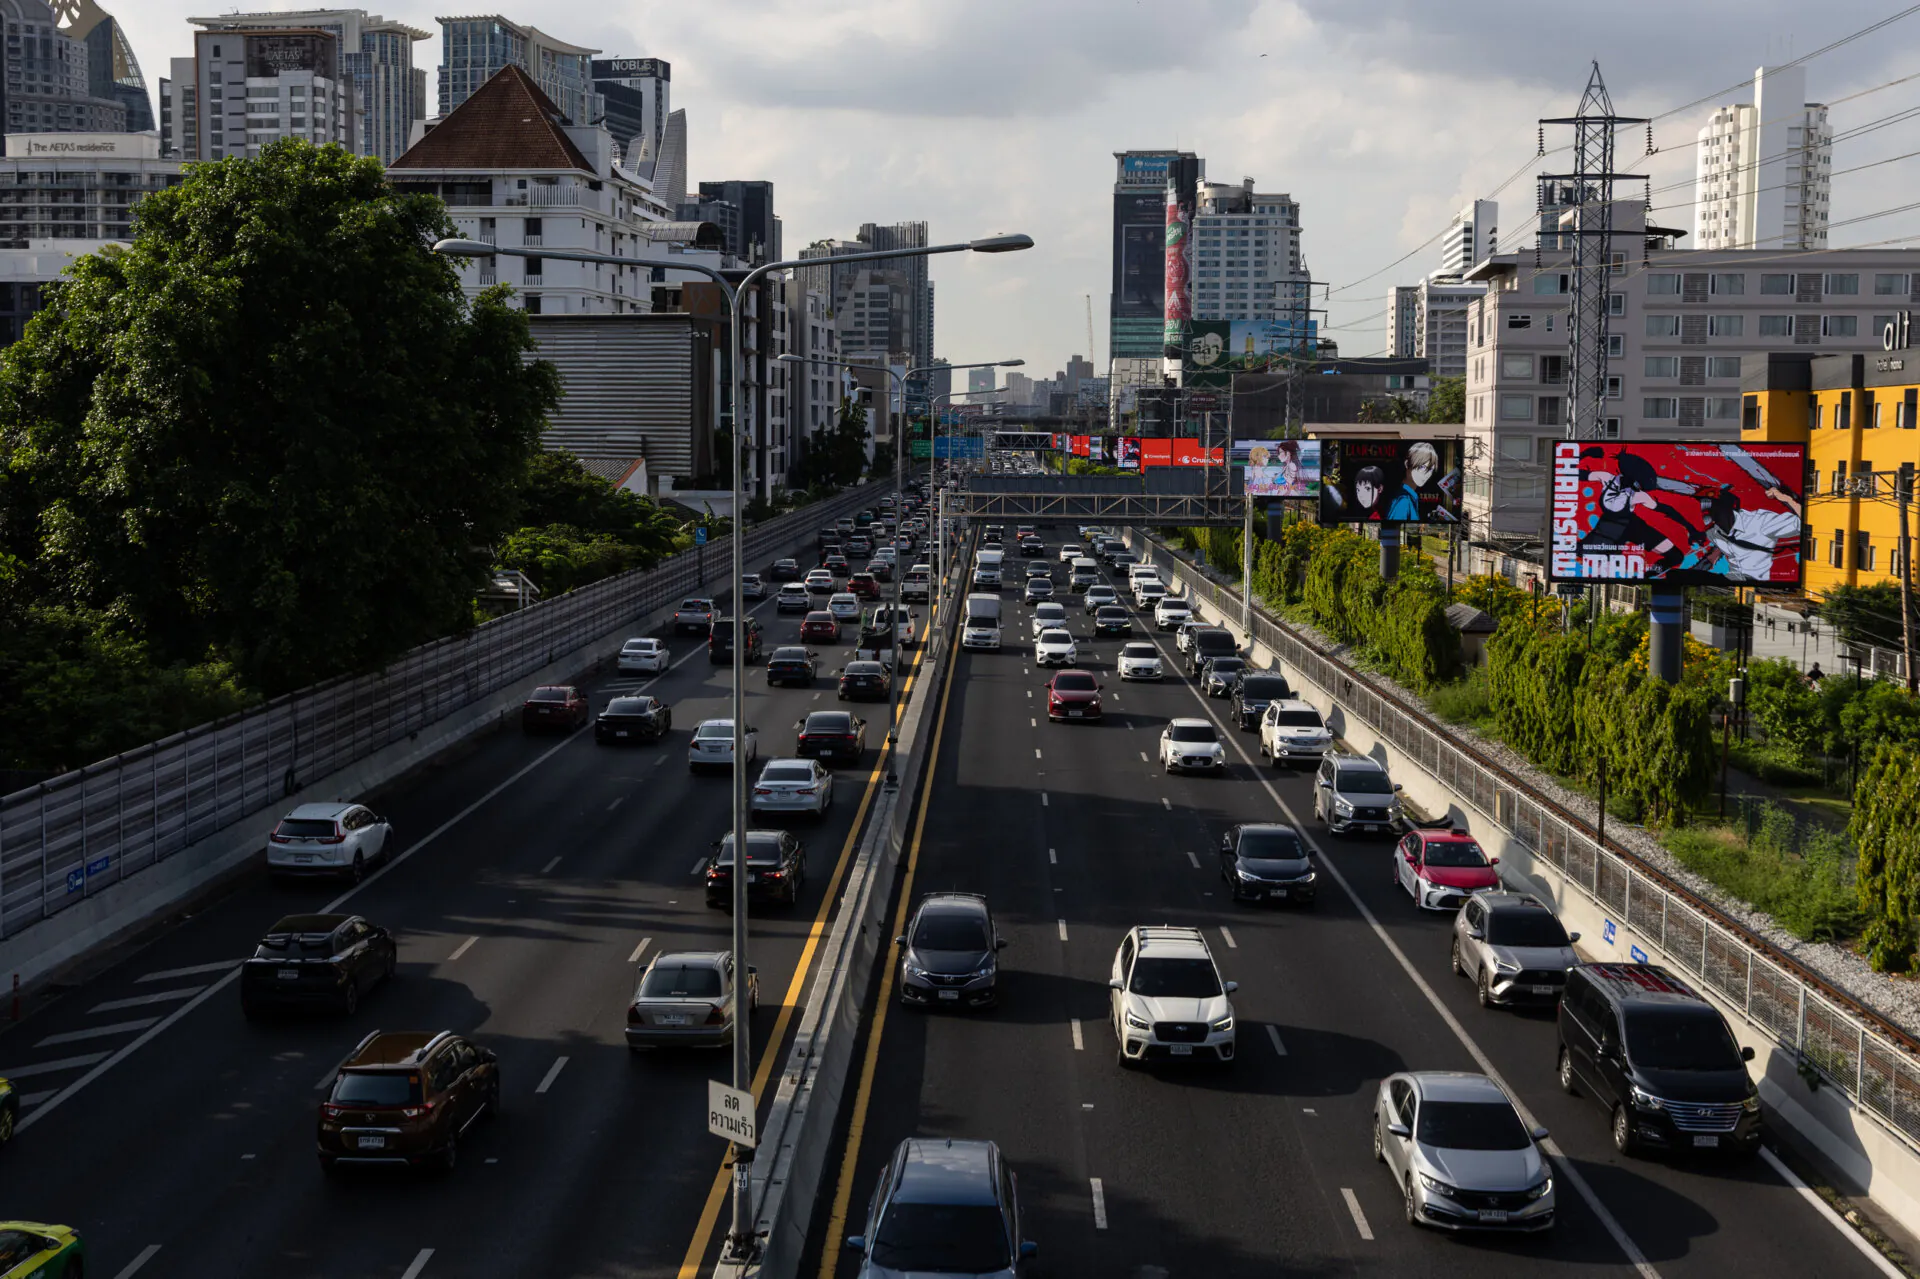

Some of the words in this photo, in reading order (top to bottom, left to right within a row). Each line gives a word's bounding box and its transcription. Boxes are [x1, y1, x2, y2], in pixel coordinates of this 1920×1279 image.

[611, 60, 651, 71] NOBLE
[33, 143, 47, 151] The
[50, 143, 75, 151] AETAS
[77, 143, 116, 152] residence
[1884, 310, 1909, 351] alt
[1552, 443, 1580, 577] CHAINSAW
[1582, 554, 1645, 579] MAN
[724, 1094, 740, 1112] ลด
[711, 1111, 753, 1139] ความเร็ว
